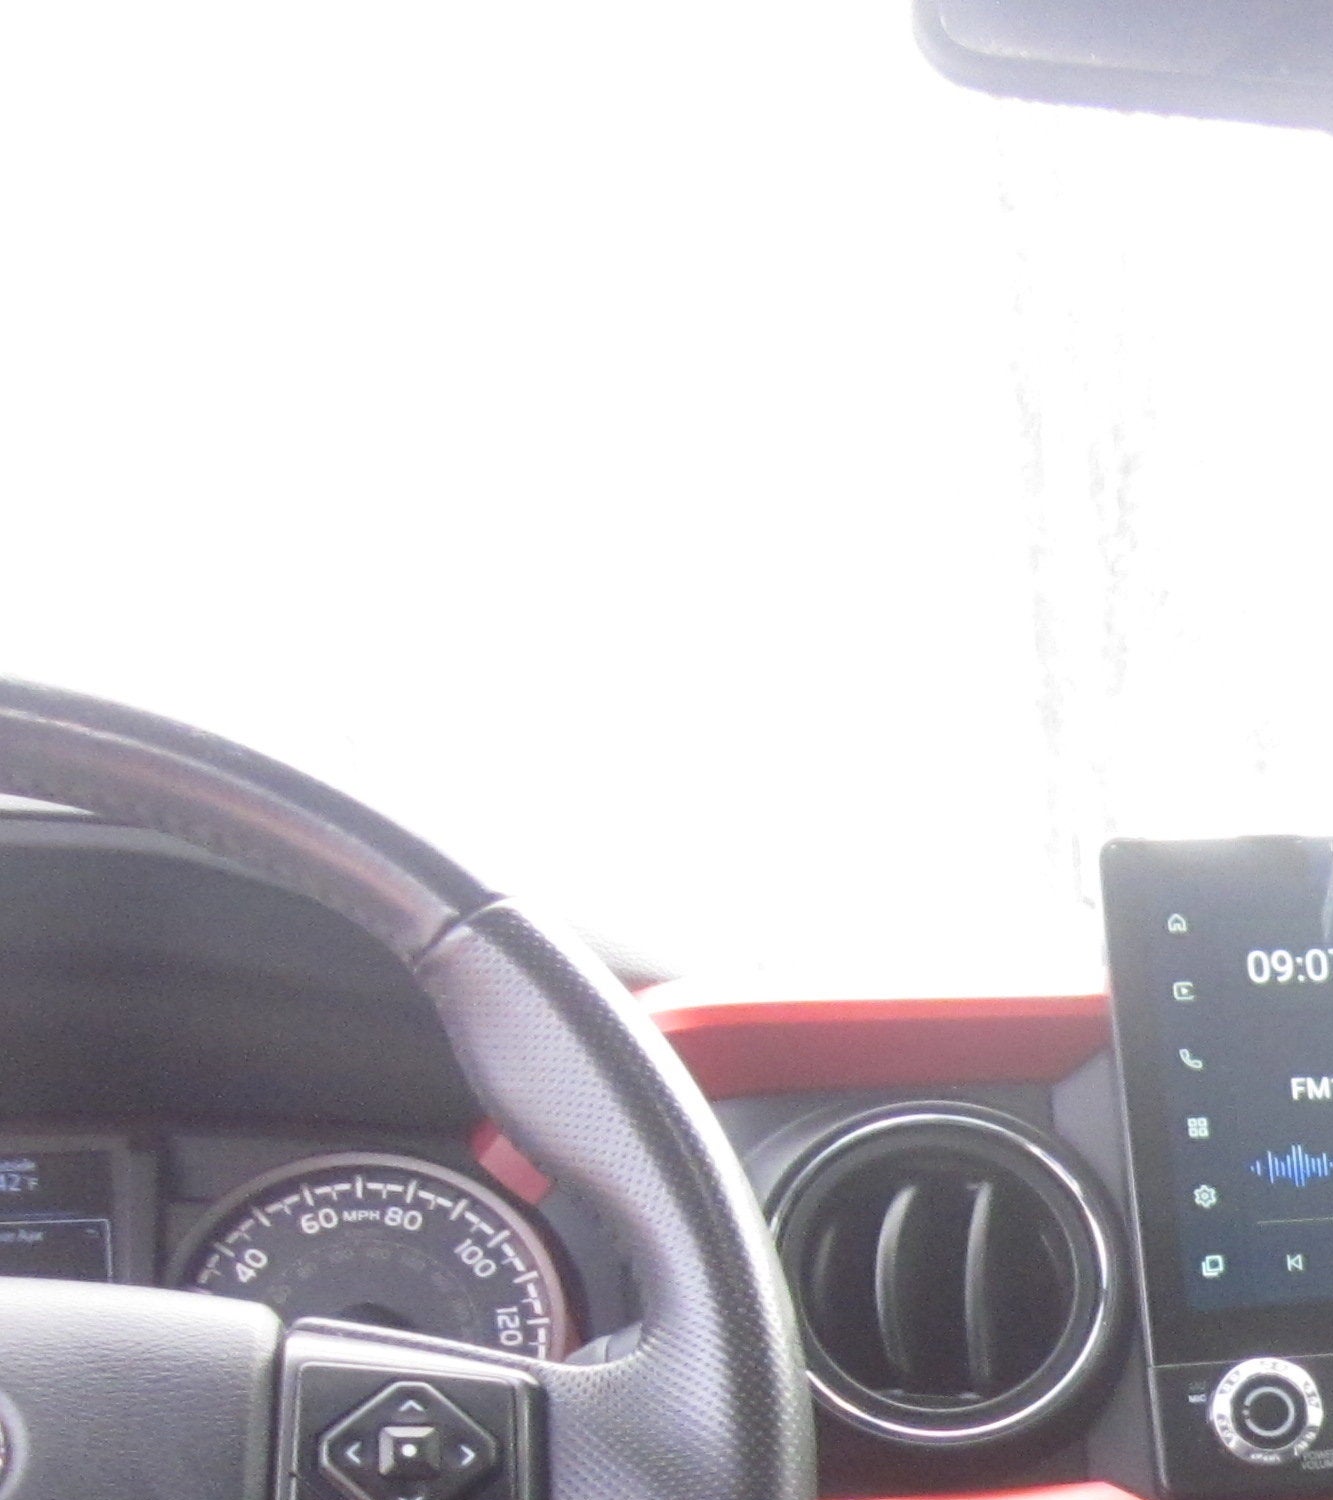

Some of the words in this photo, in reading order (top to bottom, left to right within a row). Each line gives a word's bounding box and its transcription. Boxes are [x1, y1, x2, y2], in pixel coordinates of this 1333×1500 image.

[299, 1207, 339, 1235] 60
[342, 1209, 380, 1223] MPH
[383, 1205, 423, 1232] 80
[233, 1249, 269, 1284] 40
[452, 1238, 498, 1279] 100
[495, 1306, 524, 1347] 120
